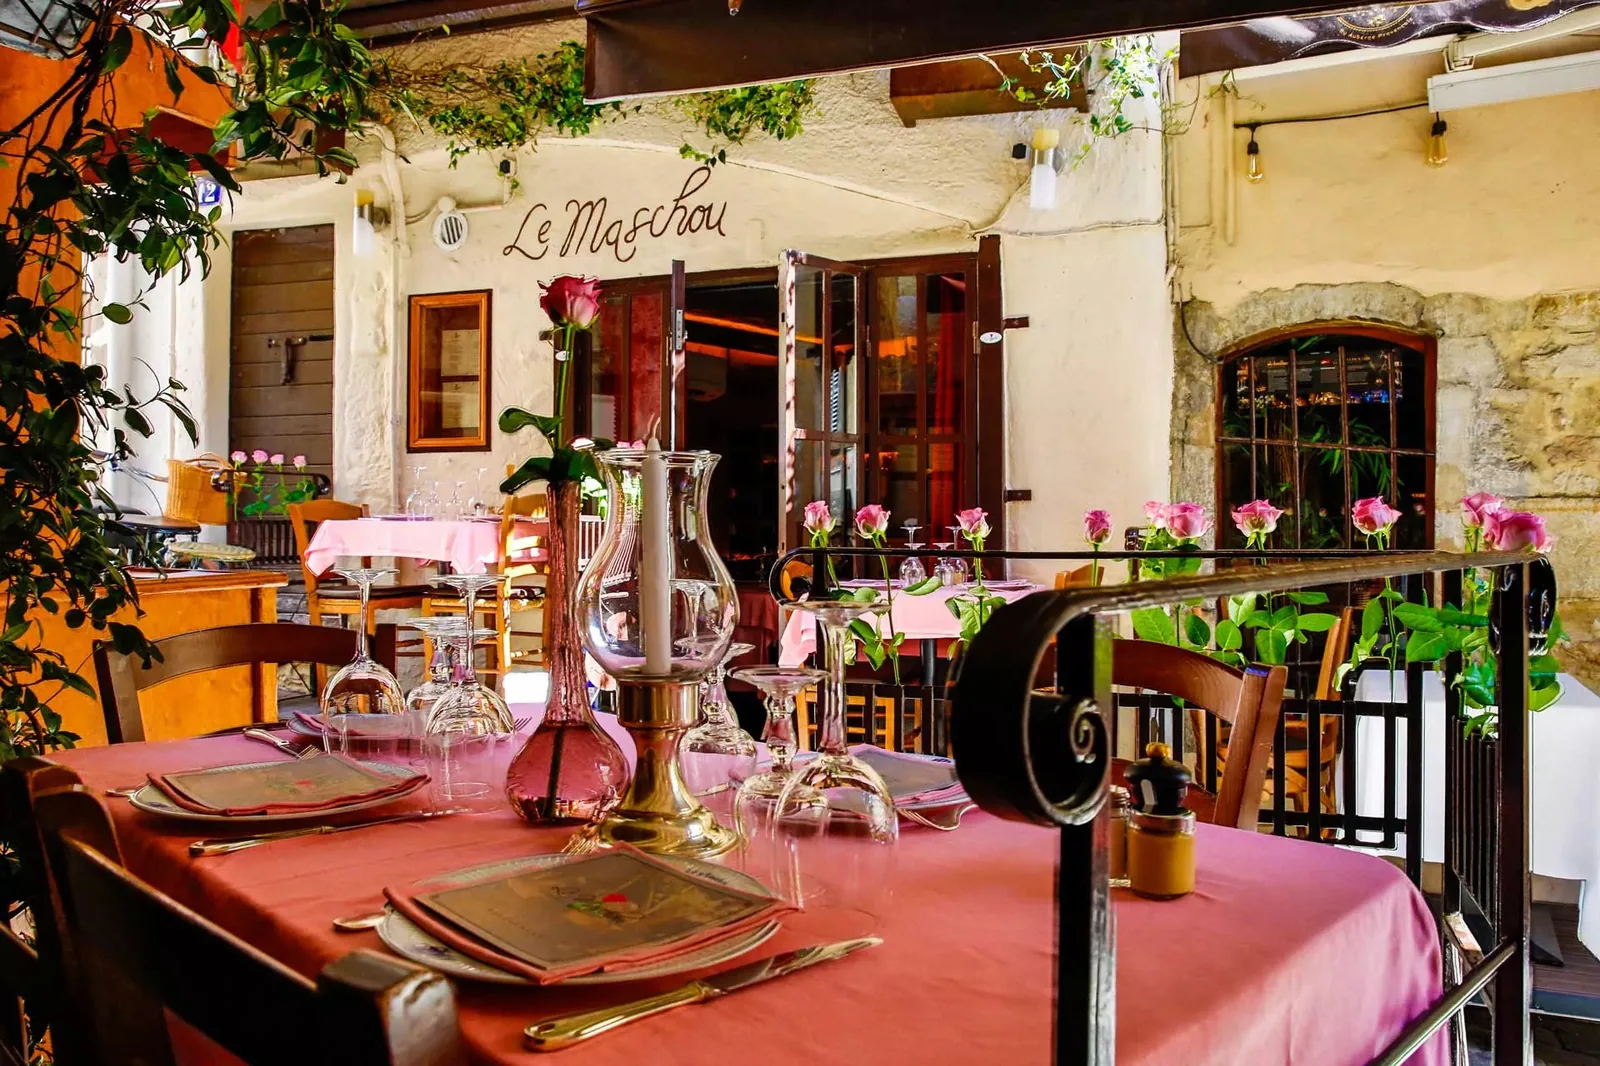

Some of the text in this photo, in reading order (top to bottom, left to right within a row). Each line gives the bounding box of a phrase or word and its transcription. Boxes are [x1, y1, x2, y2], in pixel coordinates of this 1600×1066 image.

[198, 181, 217, 204] 12
[503, 166, 727, 262] Le Maschou
